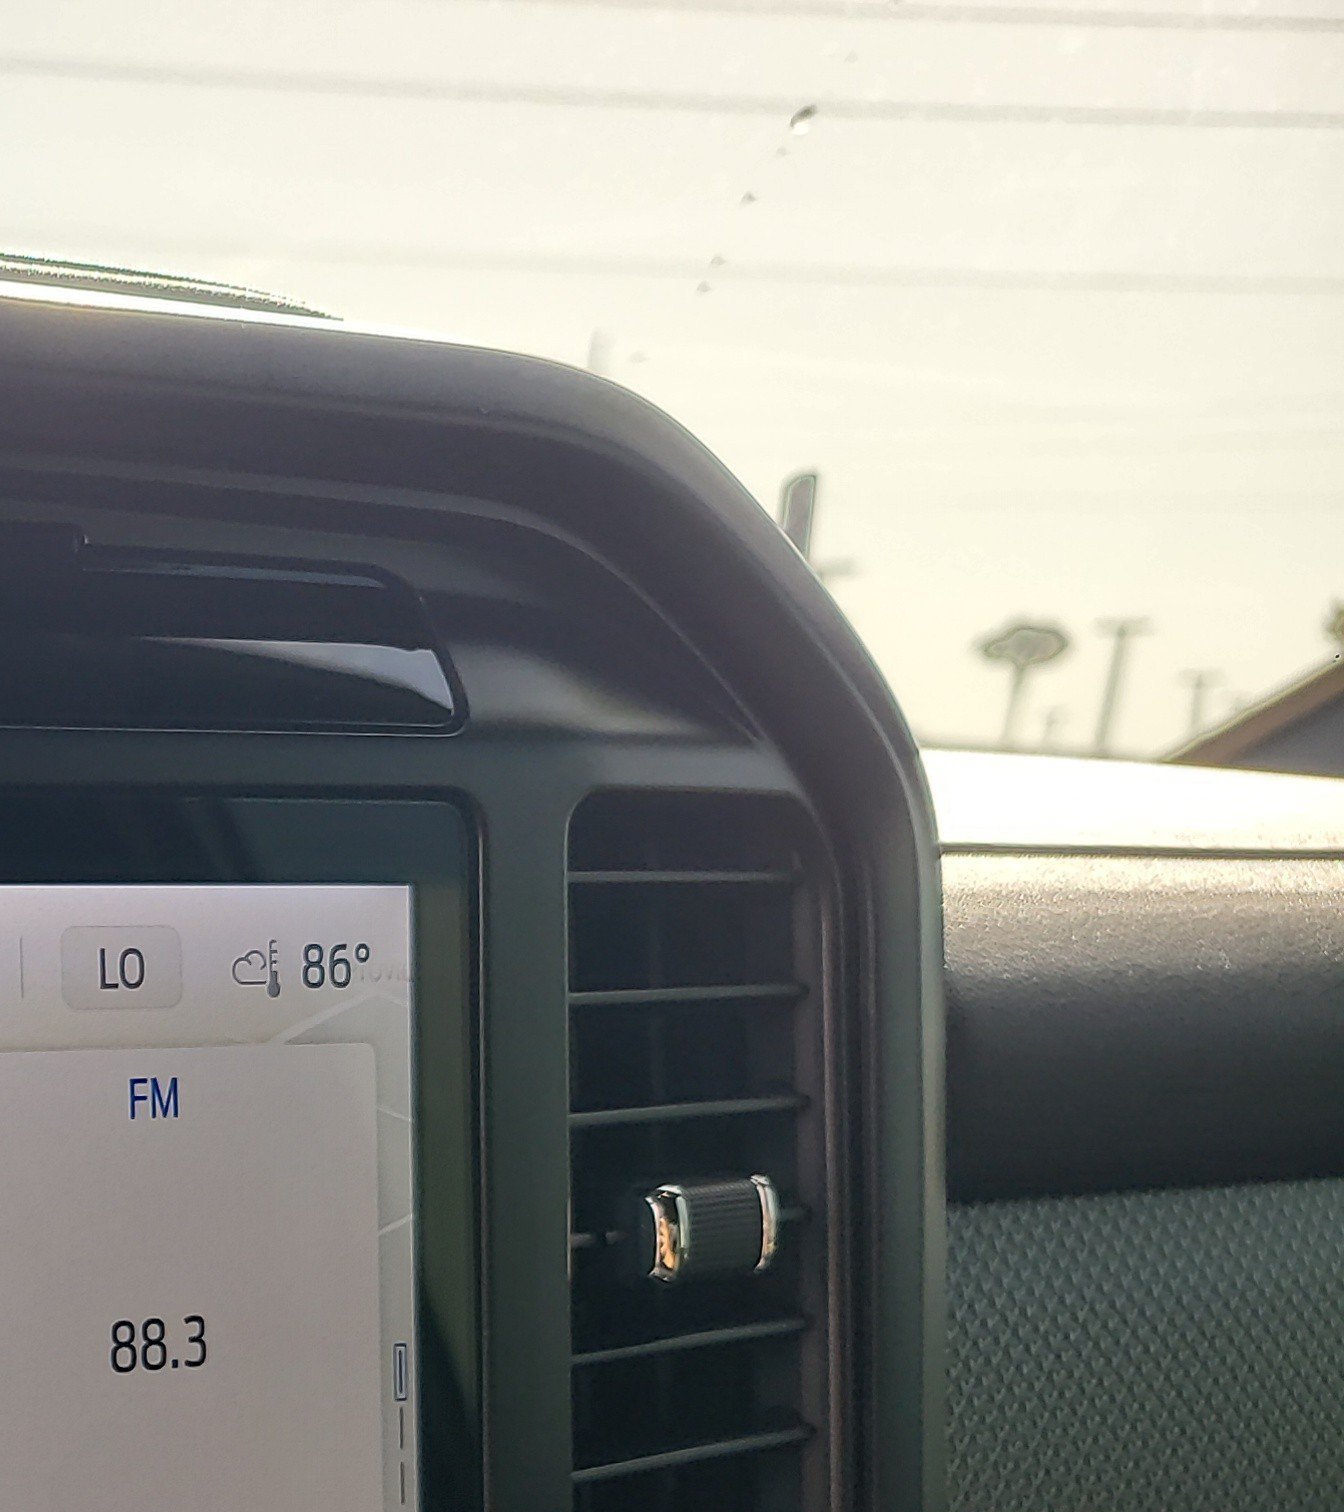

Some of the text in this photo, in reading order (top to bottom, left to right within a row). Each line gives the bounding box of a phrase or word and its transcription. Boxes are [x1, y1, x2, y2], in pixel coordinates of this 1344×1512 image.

[97, 946, 146, 990] LO
[301, 942, 371, 989] 86°
[127, 1077, 179, 1120] FM
[111, 1315, 208, 1373] 88.3
